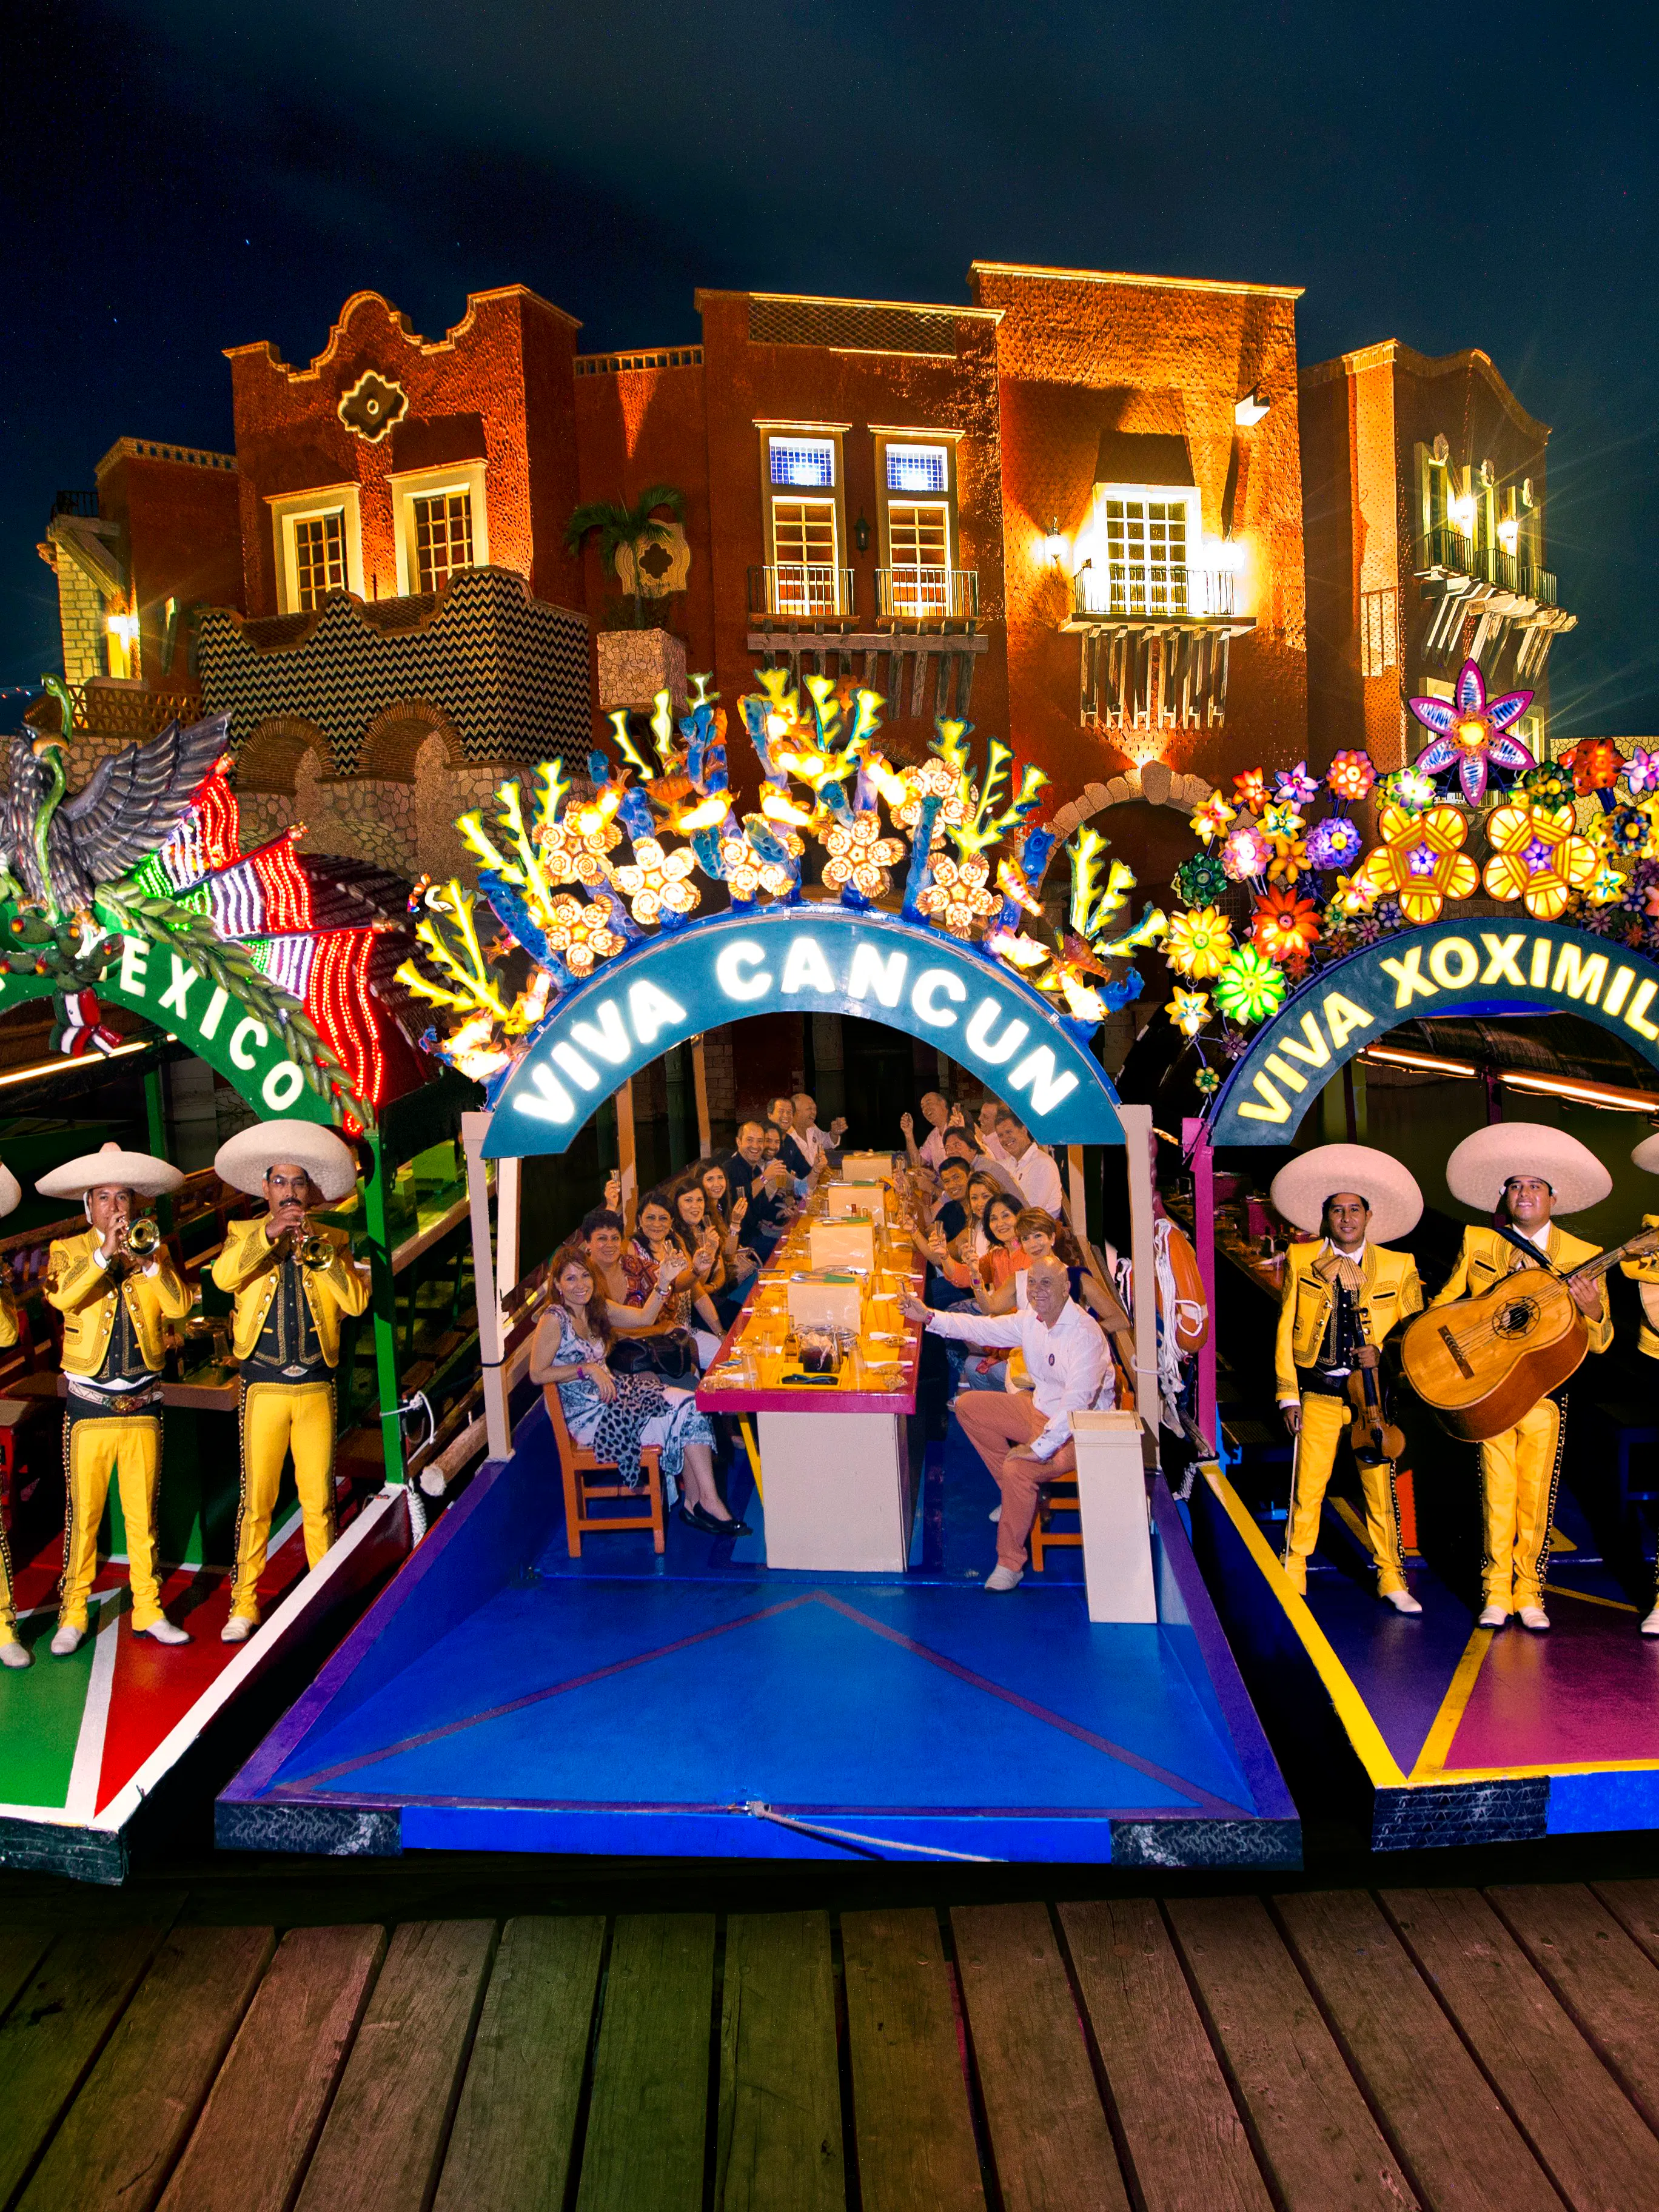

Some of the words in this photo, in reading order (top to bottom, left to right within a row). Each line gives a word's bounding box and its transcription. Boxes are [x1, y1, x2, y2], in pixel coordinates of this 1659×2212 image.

[74, 923, 304, 1111] EXICO
[513, 980, 686, 1124] VIVA
[716, 937, 1079, 1116] CANCUN
[1238, 991, 1375, 1124] VIVA
[1379, 933, 1659, 1041] XOXIMIL
